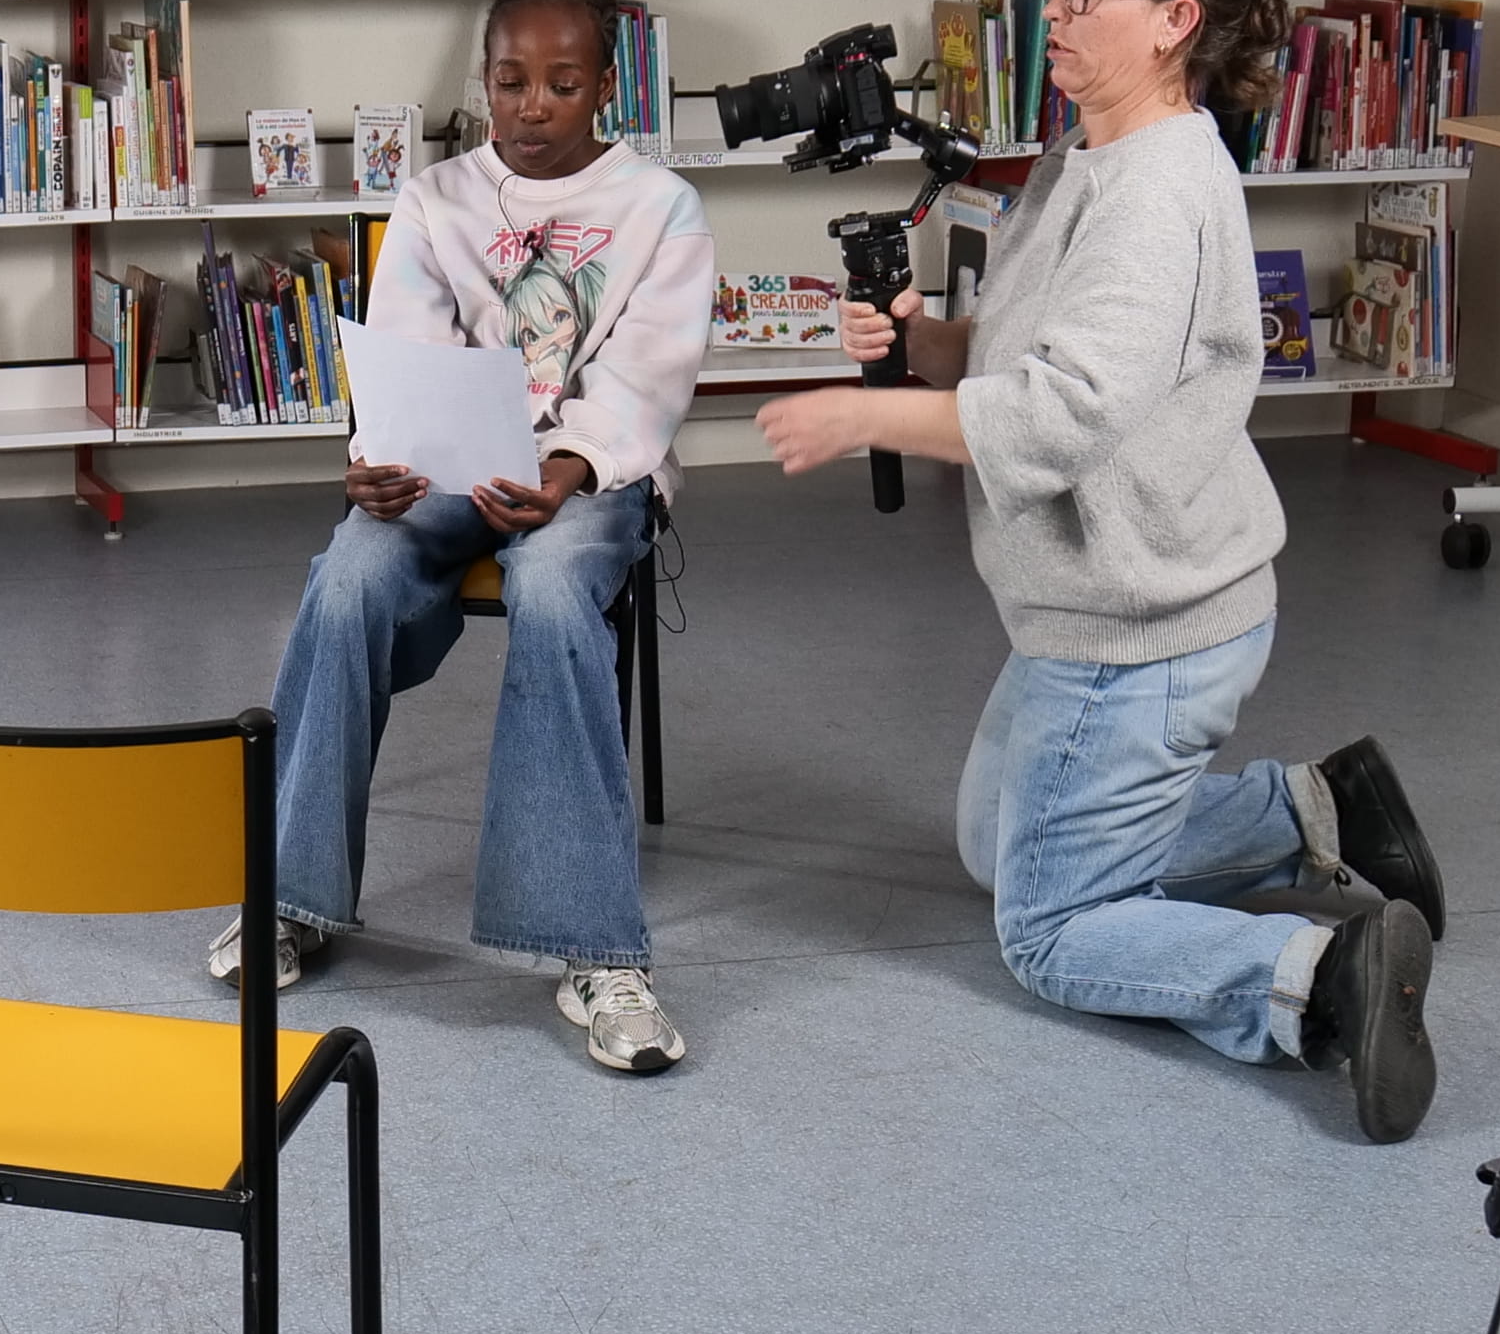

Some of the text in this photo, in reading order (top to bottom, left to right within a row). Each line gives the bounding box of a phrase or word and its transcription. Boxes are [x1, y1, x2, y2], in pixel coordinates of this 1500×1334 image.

[649, 143, 1028, 166] COUTURE/TRICOT ER/CARTON
[52, 139, 64, 192] COPAIN
[37, 207, 215, 222] CHATS CUISINE DU MONDE
[747, 274, 786, 293] 365
[752, 310, 772, 320] pour
[132, 430, 183, 438] INDUSTRIES
